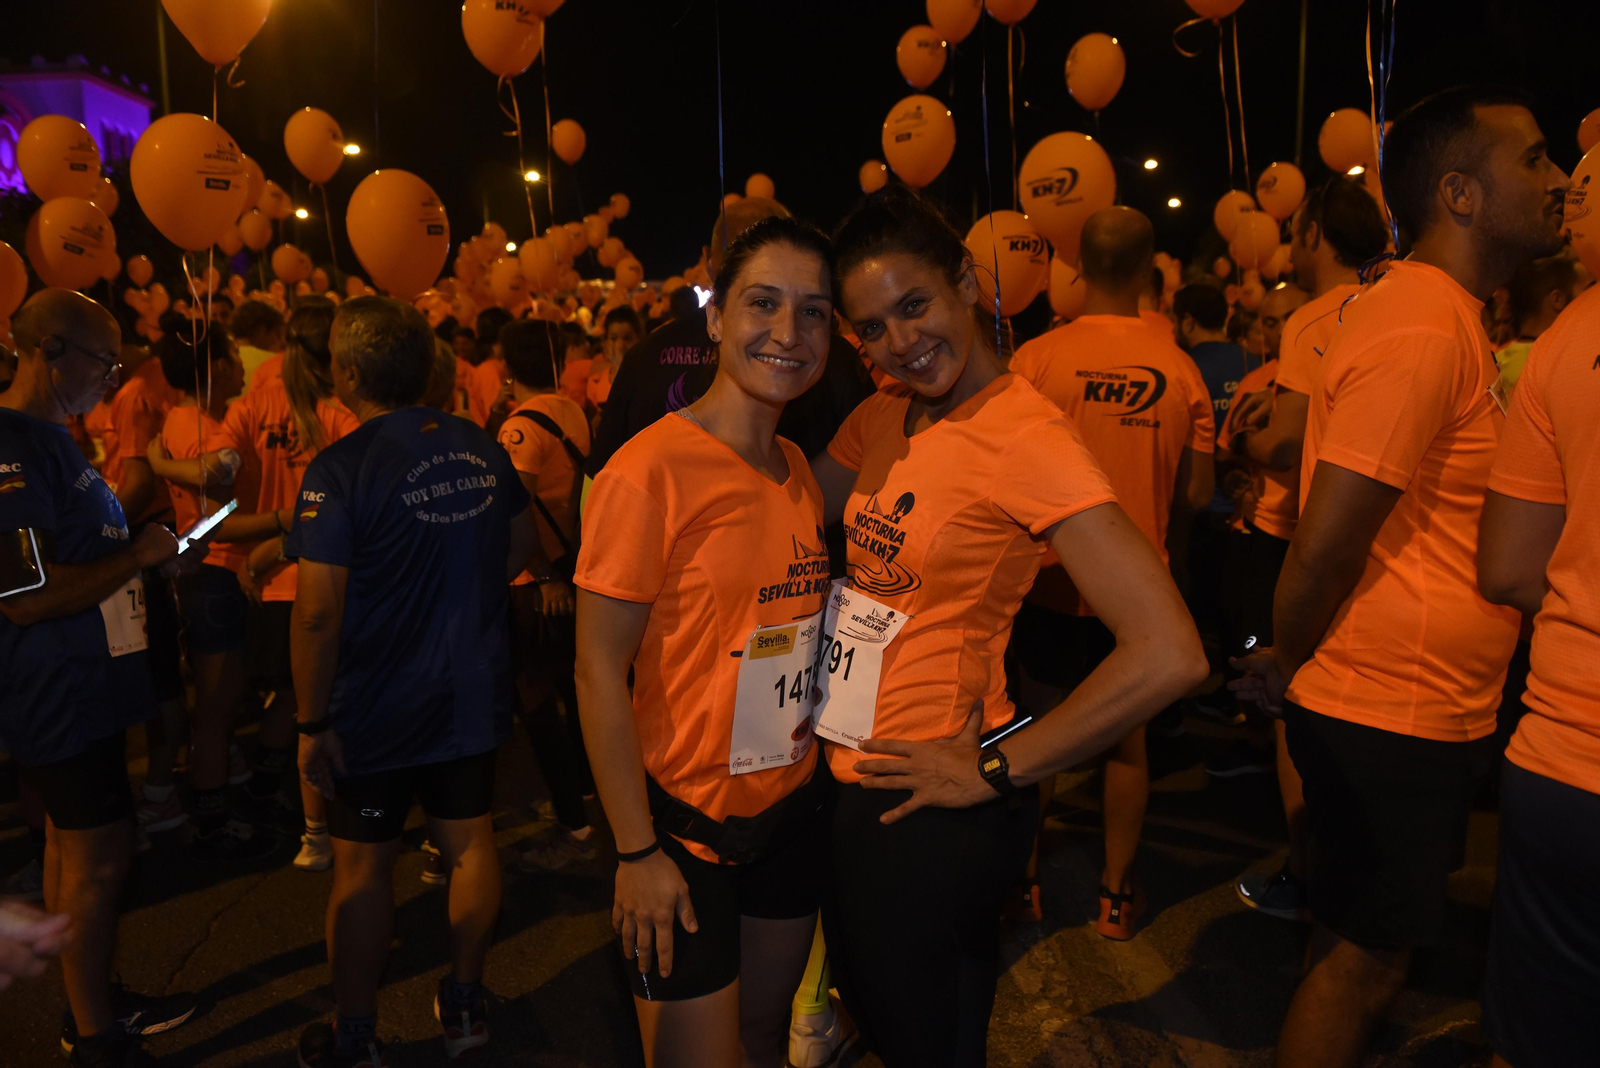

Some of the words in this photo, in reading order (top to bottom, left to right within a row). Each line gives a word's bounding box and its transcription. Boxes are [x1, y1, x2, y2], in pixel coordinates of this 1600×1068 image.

[660, 346, 700, 366] CORRE
[1075, 370, 1128, 381] NOCTURNA
[406, 460, 431, 483] Club
[432, 455, 445, 465] de
[448, 451, 487, 468] Amigos
[303, 490, 326, 503] V&C
[401, 488, 429, 507] VOY
[430, 482, 455, 498] DEL
[456, 474, 497, 491] CARAJO
[416, 509, 430, 521] de
[430, 512, 451, 524] Dos
[452, 494, 493, 523] Hermanas
[854, 511, 907, 546] NOCTURNA
[758, 579, 812, 604] SEVILLA
[850, 614, 875, 630] SEVILLA
[865, 614, 891, 629] NOCTURNA
